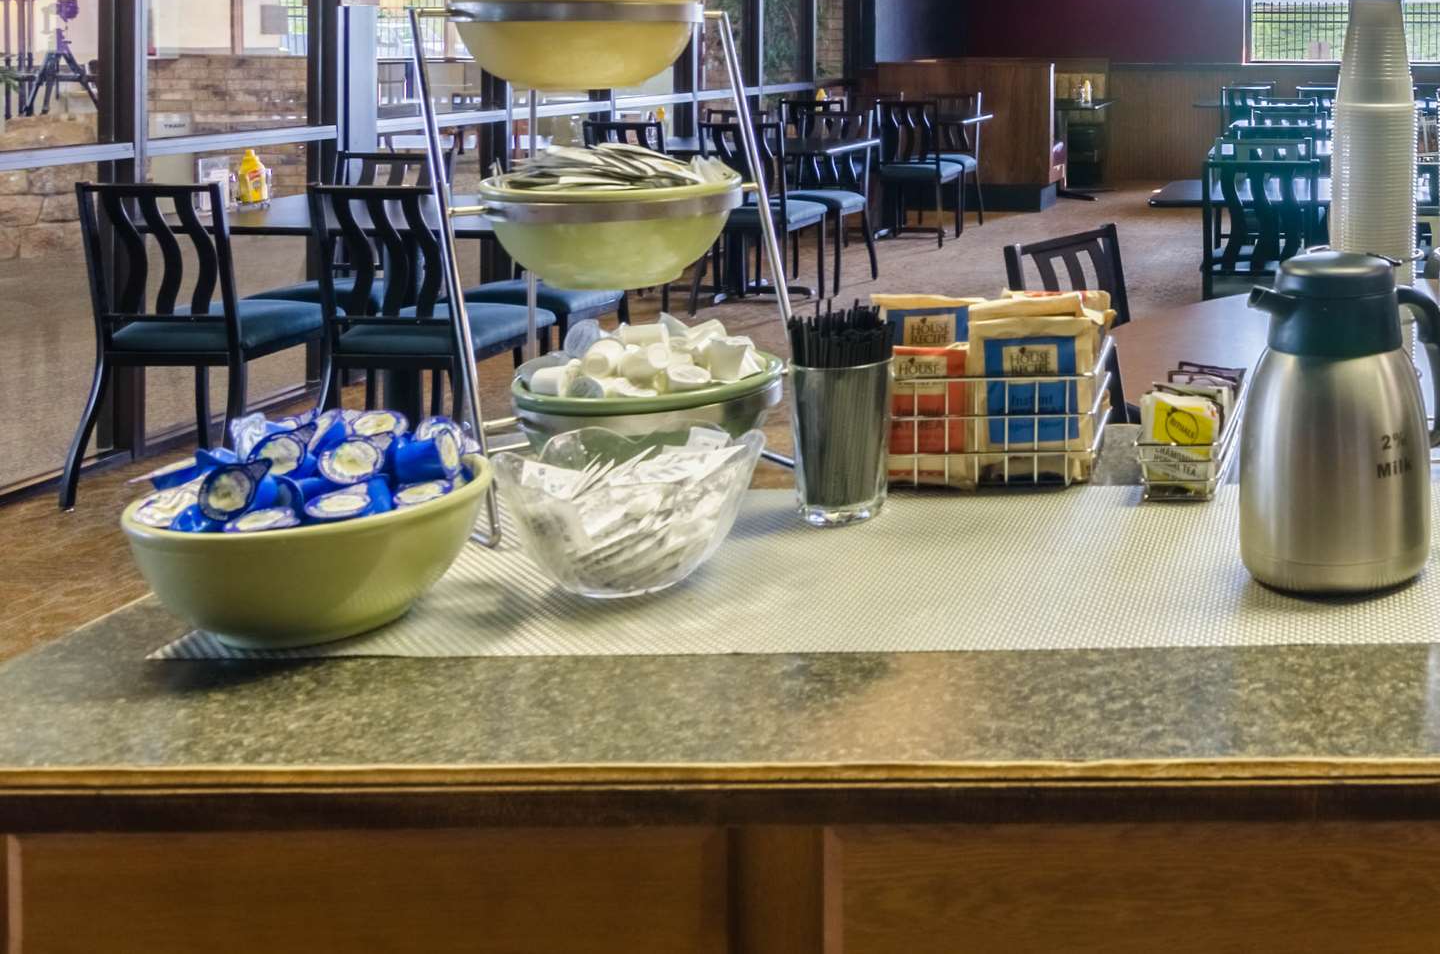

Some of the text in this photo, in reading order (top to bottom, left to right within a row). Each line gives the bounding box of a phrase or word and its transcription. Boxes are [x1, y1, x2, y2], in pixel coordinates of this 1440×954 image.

[911, 324, 949, 335] HOUSE
[911, 334, 948, 344] RECIPE
[1009, 352, 1050, 364] HOUSE
[899, 363, 939, 375] HOUSE
[1382, 431, 1408, 450] 2%
[1376, 457, 1412, 478] Milk
